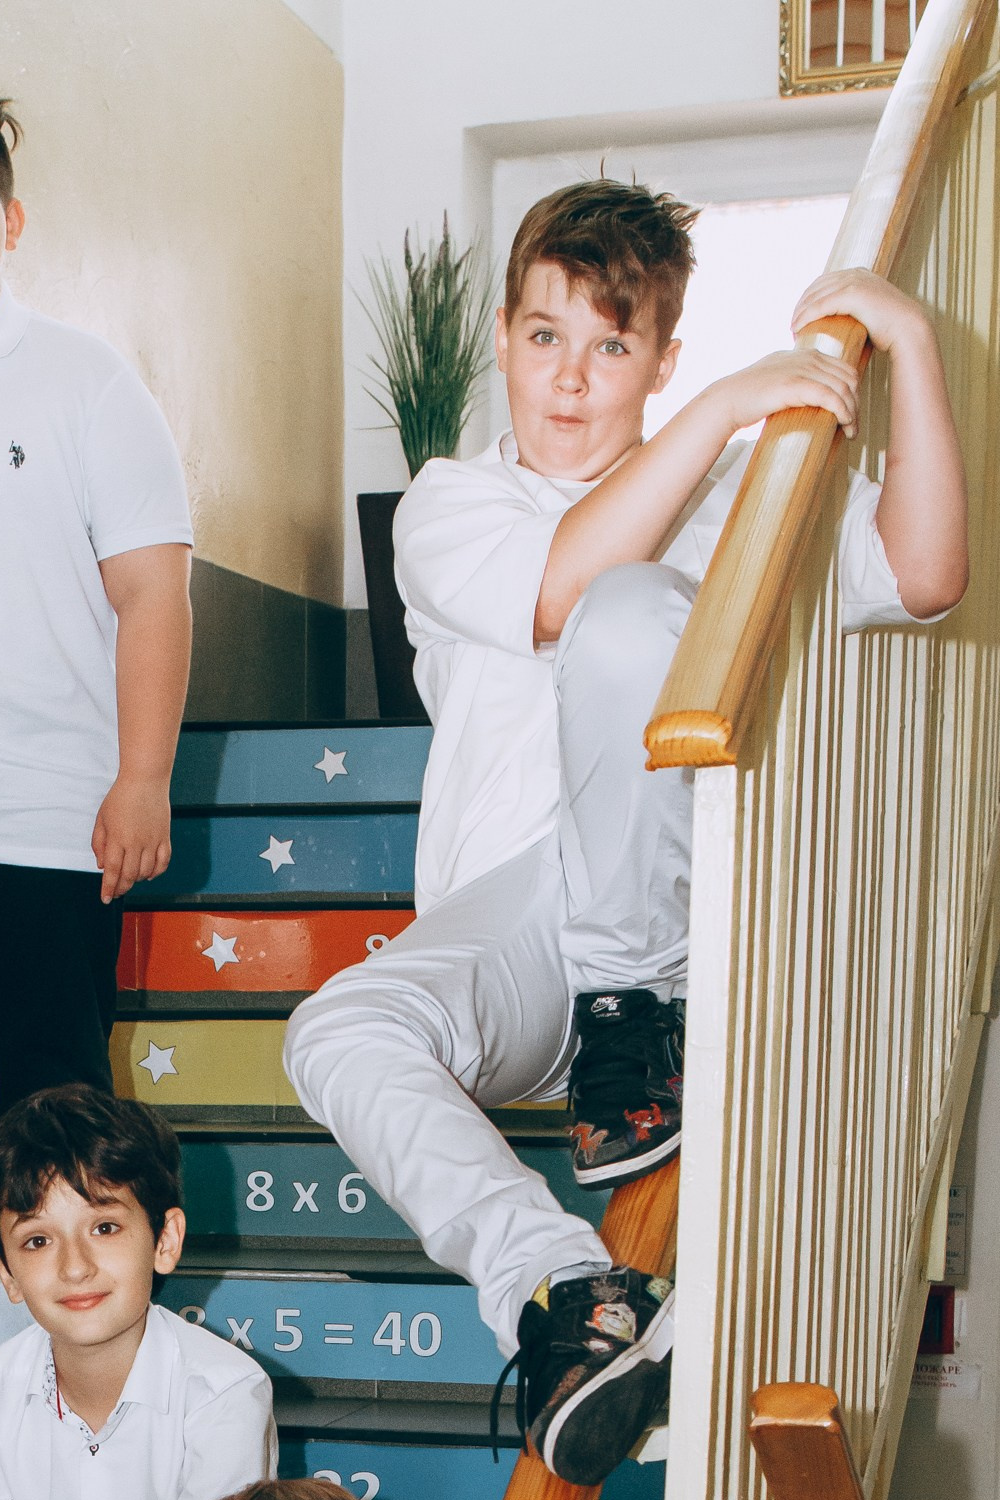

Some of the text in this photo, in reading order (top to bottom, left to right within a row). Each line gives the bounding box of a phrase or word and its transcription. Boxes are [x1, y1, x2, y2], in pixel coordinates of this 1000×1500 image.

[245, 1170, 367, 1214] 8 x 6
[273, 1308, 303, 1352] 5
[372, 1311, 443, 1357] 40
